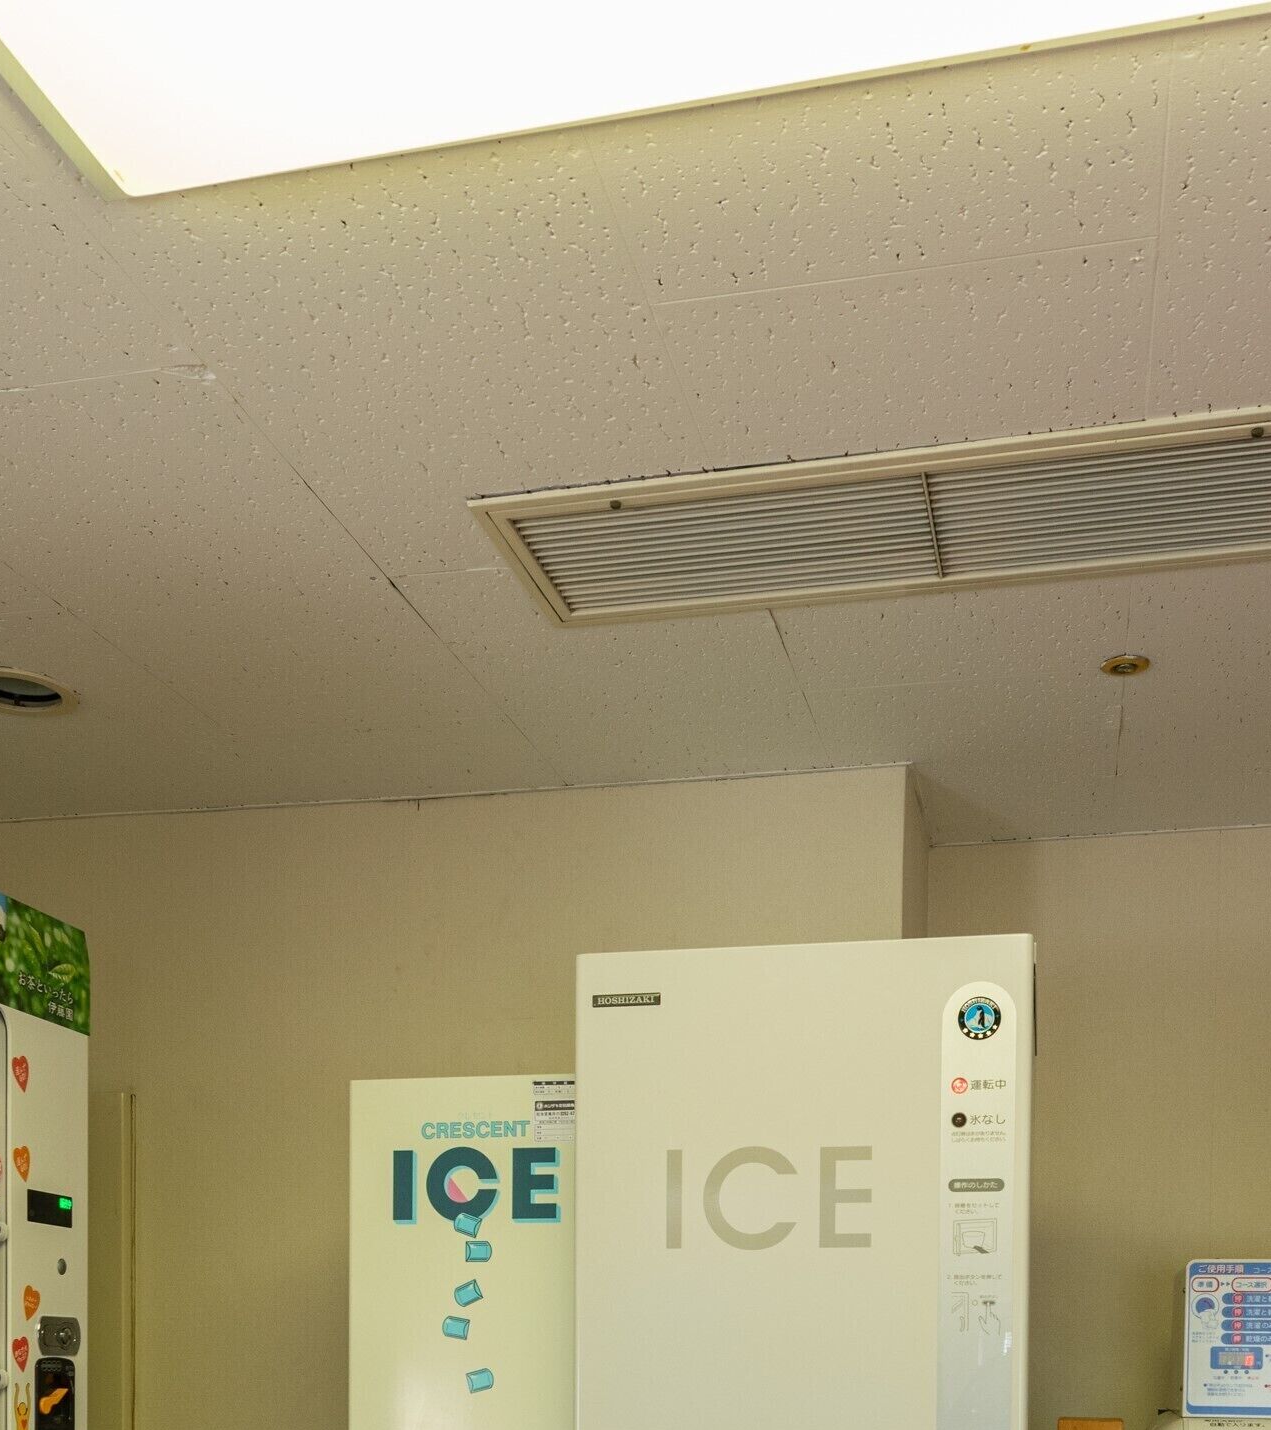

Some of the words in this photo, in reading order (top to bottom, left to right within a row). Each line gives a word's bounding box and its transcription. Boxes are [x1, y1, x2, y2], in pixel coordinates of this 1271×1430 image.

[597, 995, 657, 1006] HOSHIZAKI
[47, 1001, 75, 1023] 伊藤園
[970, 1079, 1007, 1091] 運転中
[969, 1113, 1007, 1126] 氷なし
[421, 1119, 531, 1141] CRESCENT
[392, 1145, 562, 1225] ICE
[665, 1145, 873, 1251] ICE
[1198, 1264, 1244, 1274] ご使用手順
